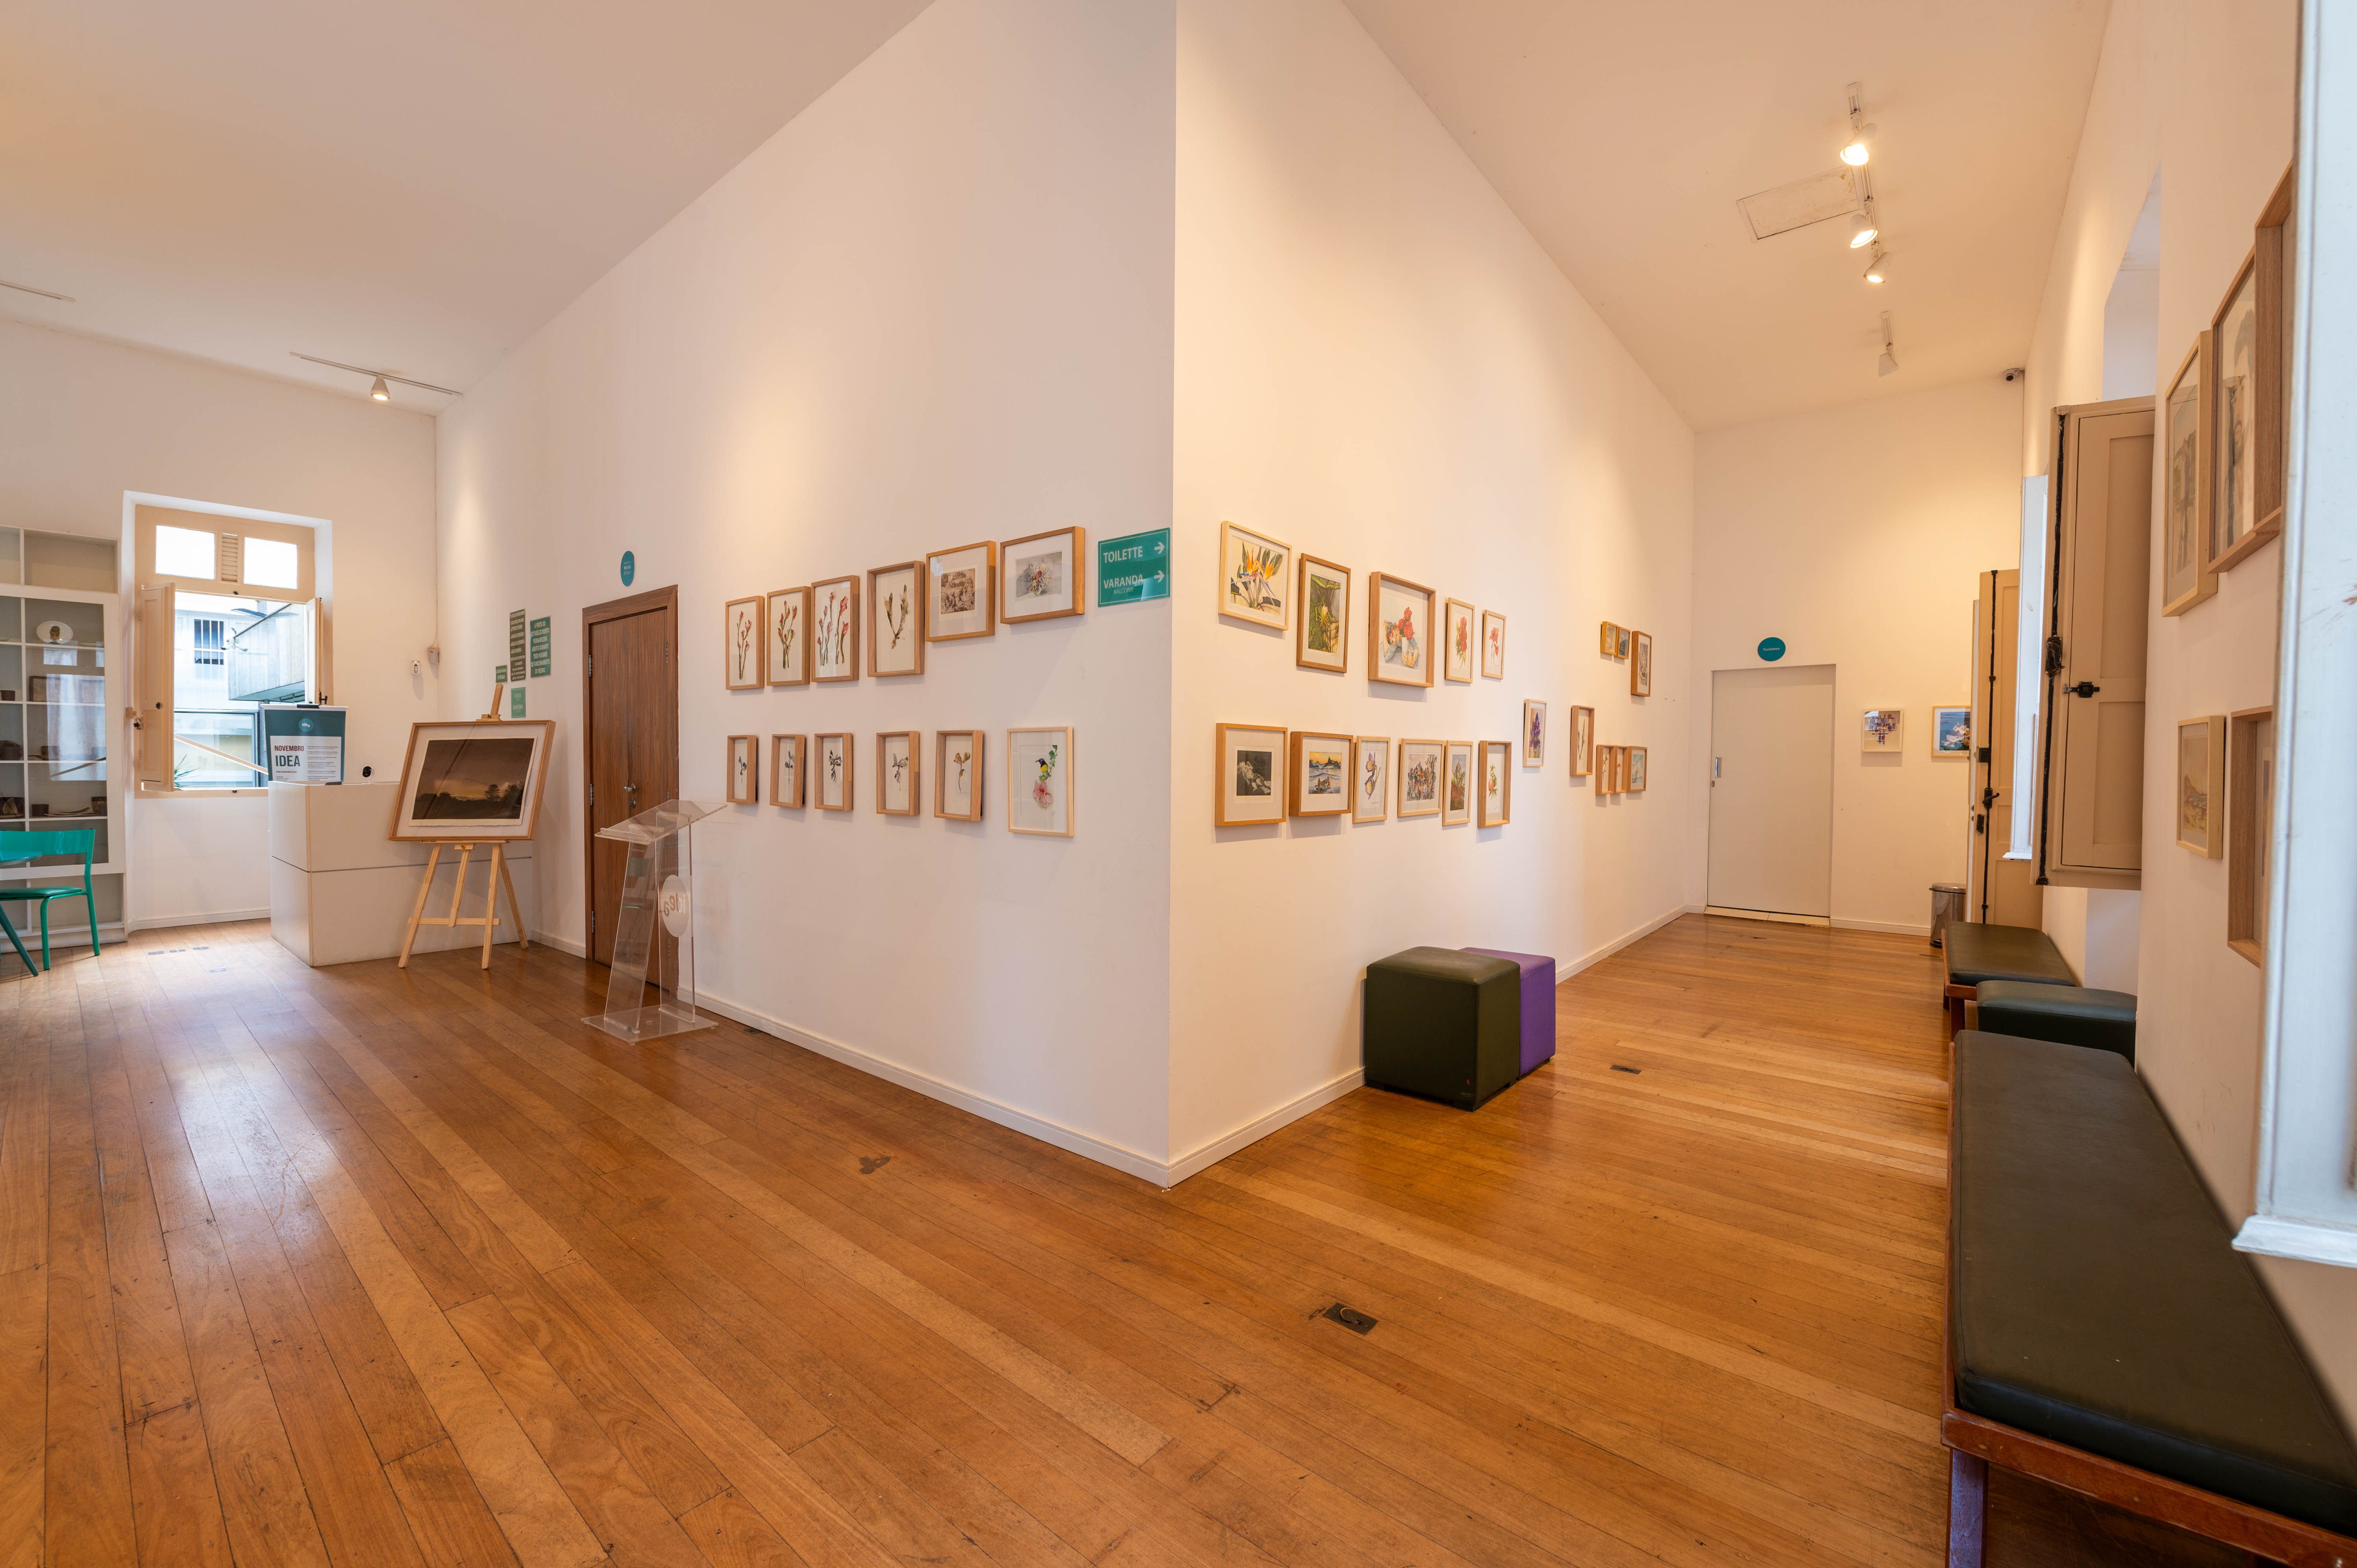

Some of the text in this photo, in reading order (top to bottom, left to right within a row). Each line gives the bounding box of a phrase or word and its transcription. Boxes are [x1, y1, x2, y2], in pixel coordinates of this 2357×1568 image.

[1103, 546, 1143, 563] TOILETTE
[1103, 574, 1143, 589] VARANDA
[276, 755, 300, 767] IDEA
